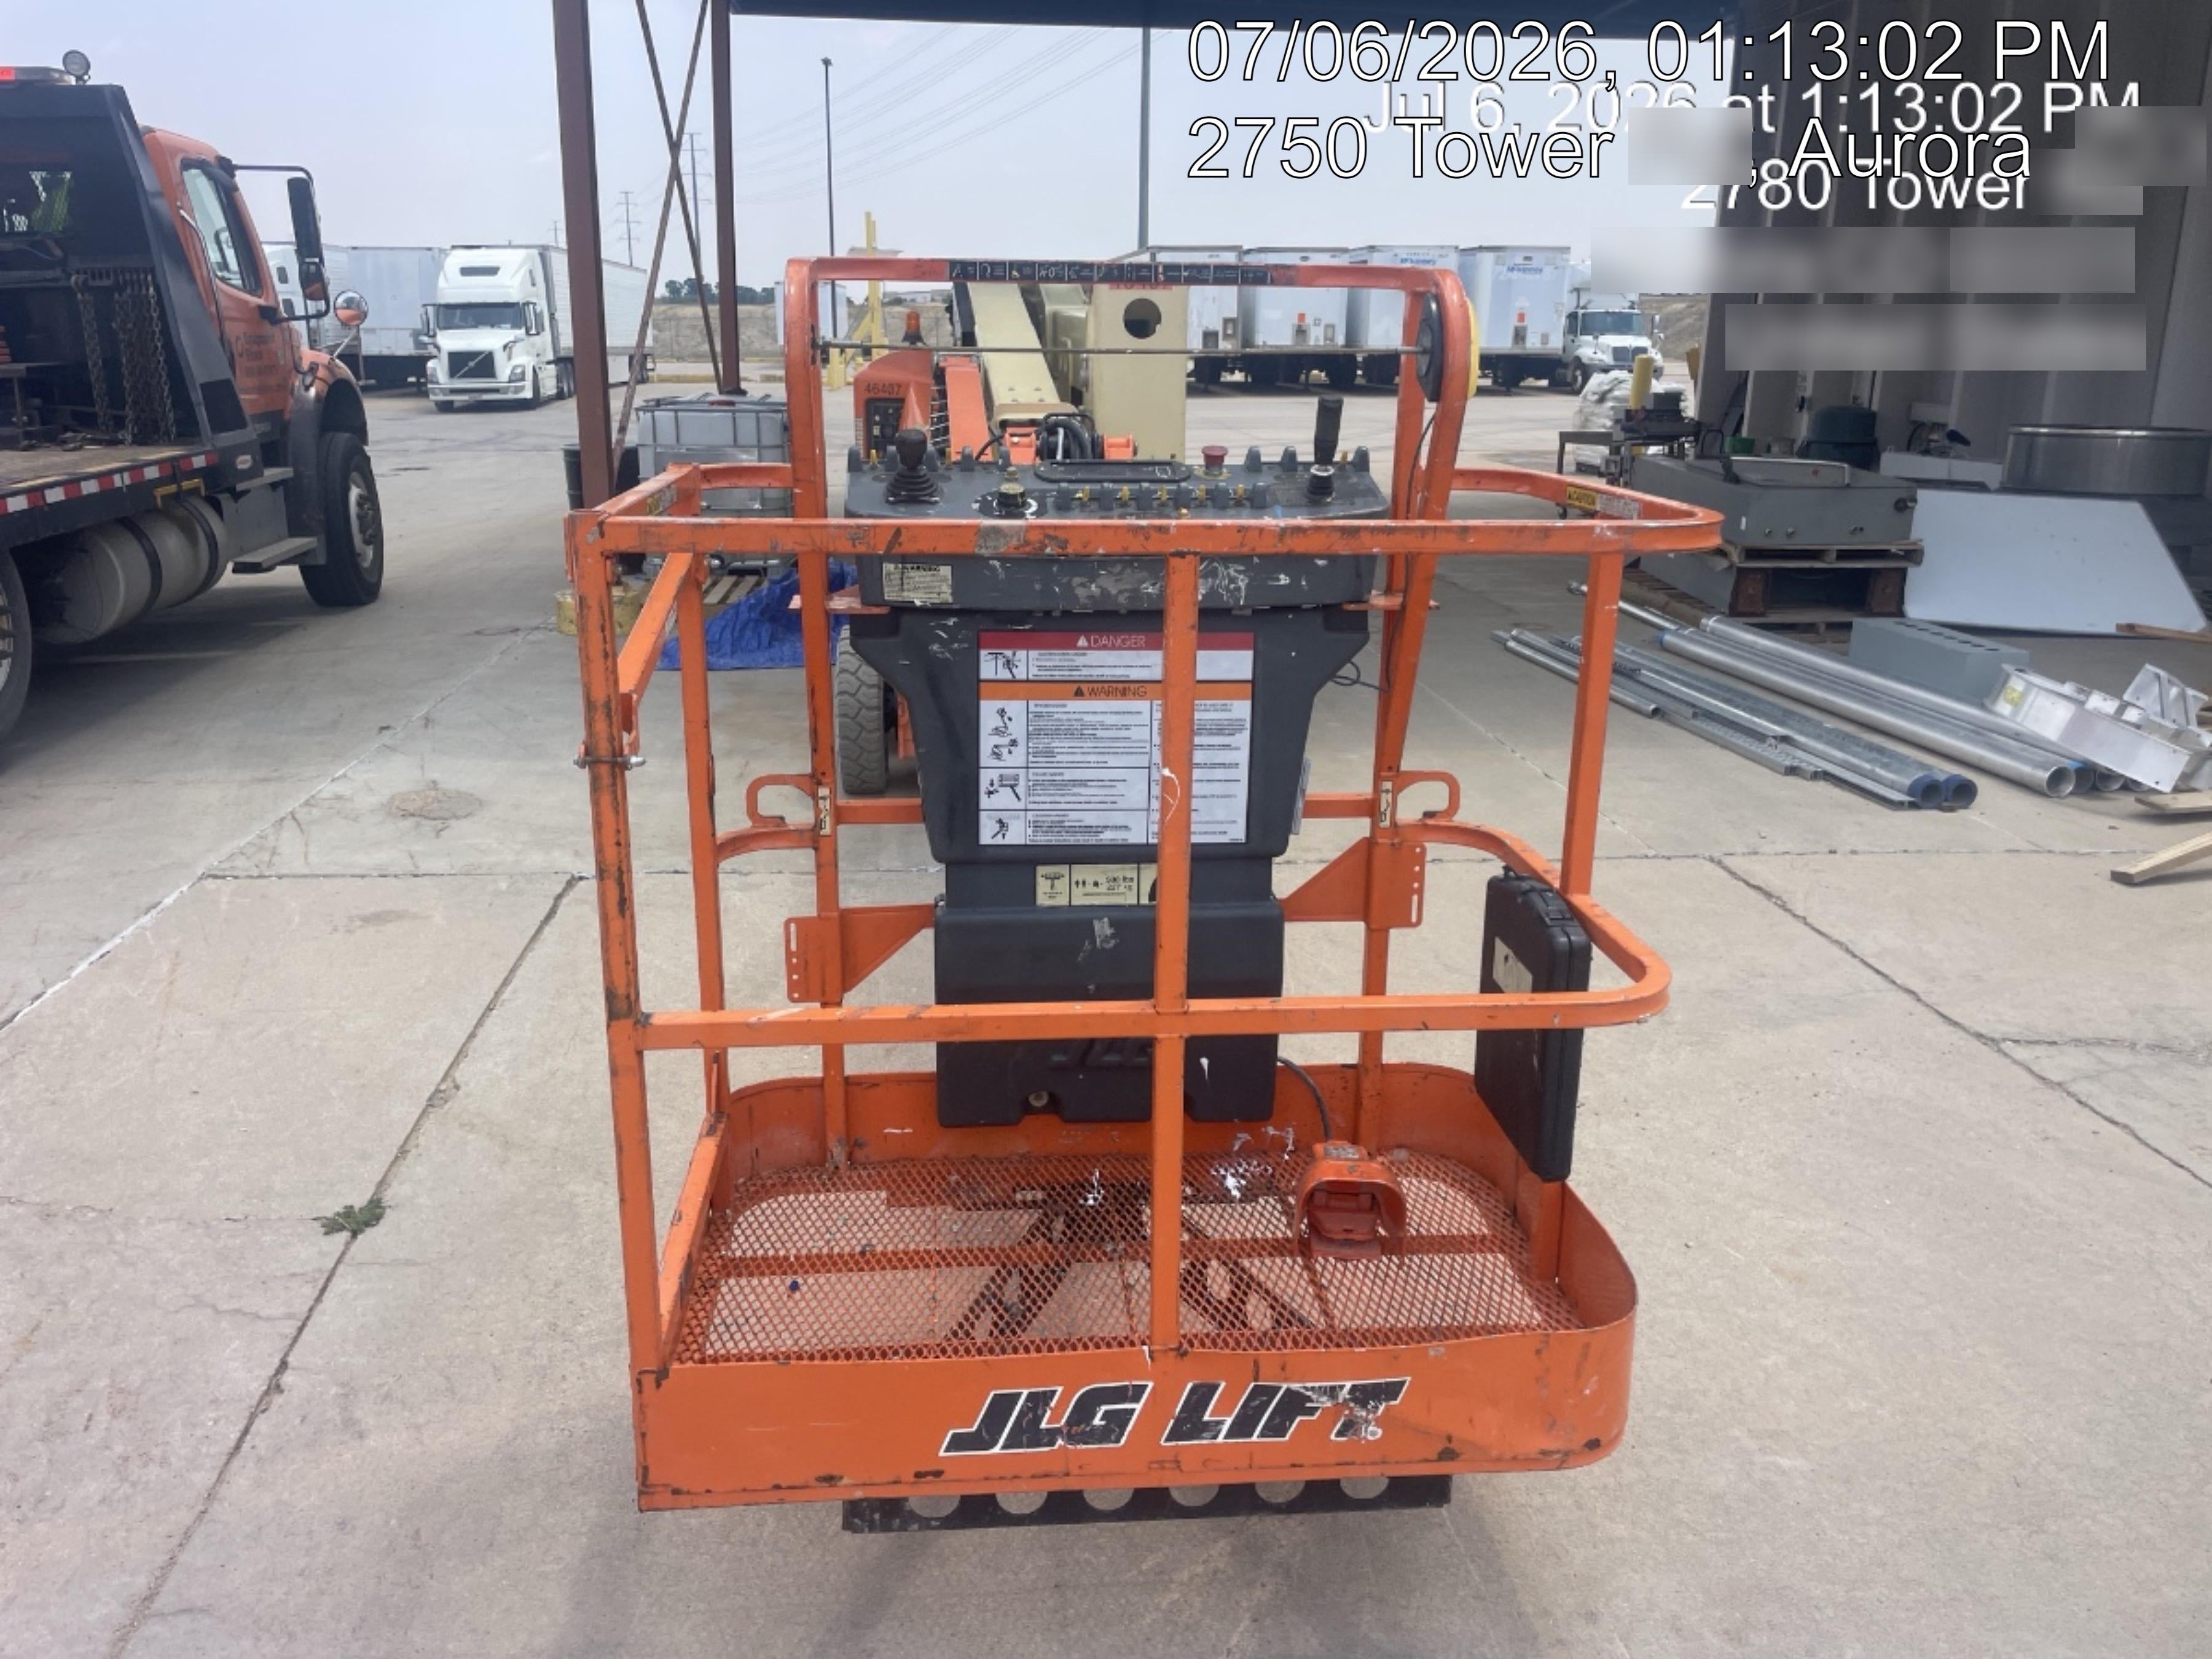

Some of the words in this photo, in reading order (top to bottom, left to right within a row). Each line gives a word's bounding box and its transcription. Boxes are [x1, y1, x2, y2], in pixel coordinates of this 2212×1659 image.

[1090, 635, 1146, 648] DANGER
[1088, 684, 1147, 698] WARNING
[938, 1381, 1155, 1457] JLG
[1159, 1376, 1412, 1446] LIFT
